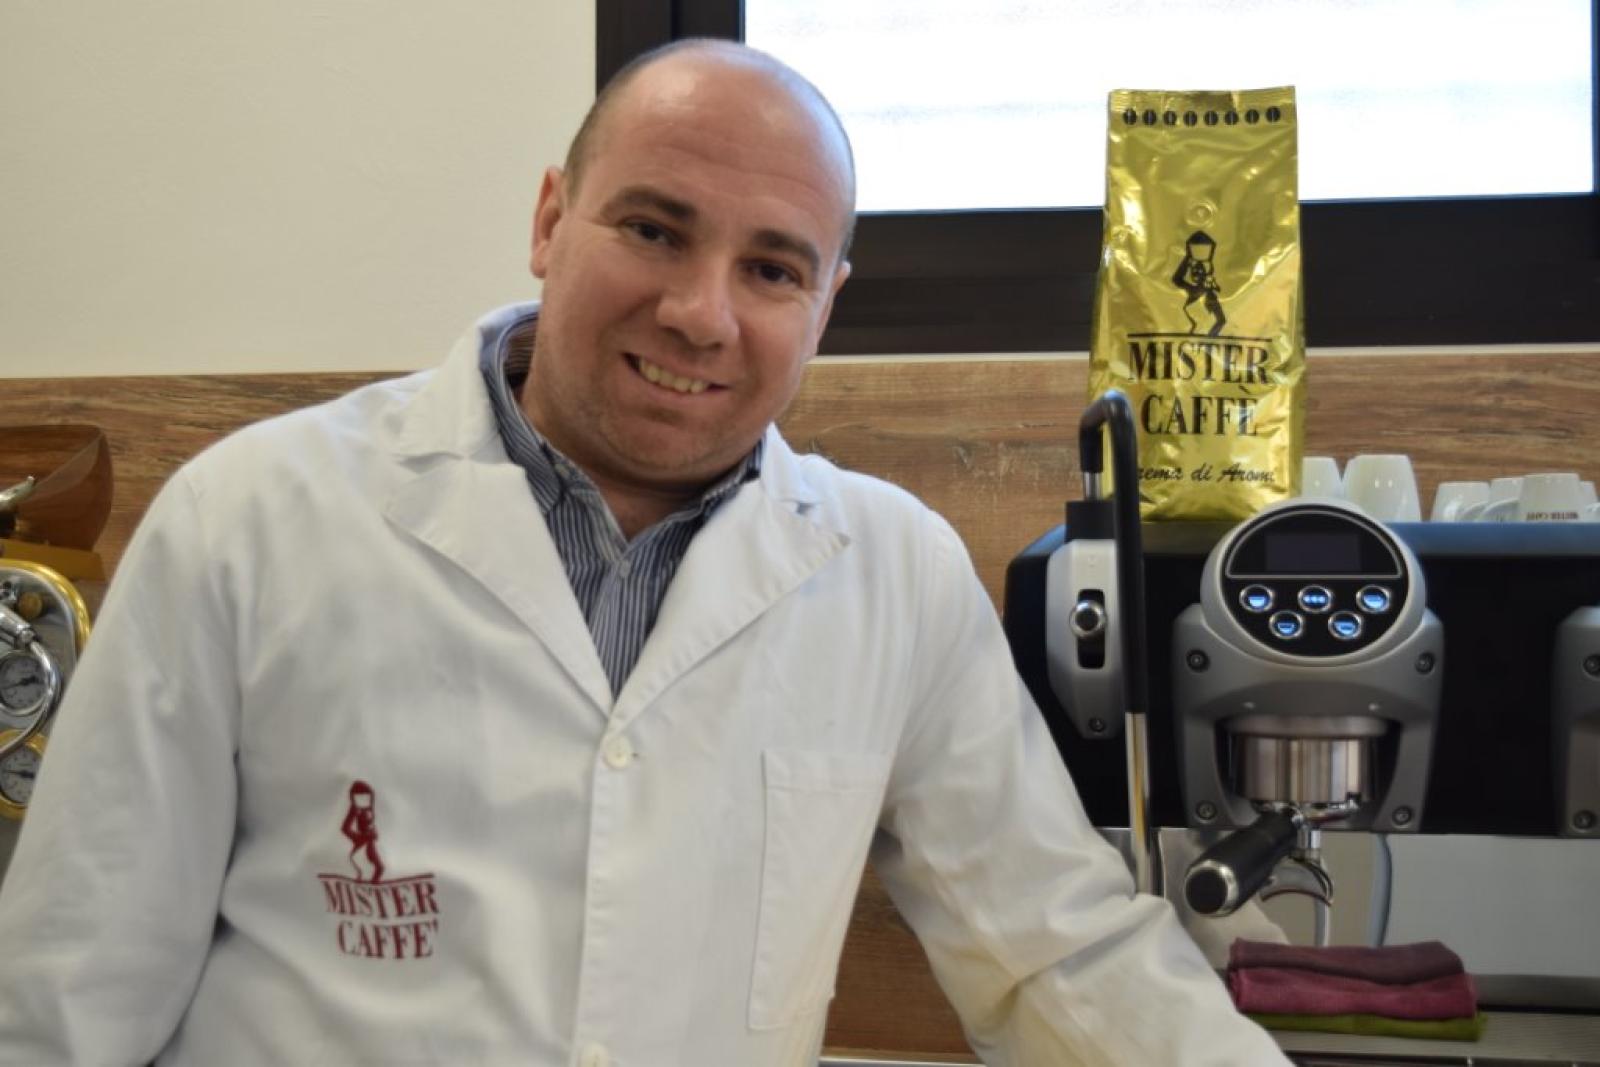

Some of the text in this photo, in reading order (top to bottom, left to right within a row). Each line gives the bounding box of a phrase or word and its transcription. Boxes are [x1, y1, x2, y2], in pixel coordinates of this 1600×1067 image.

[1128, 341, 1269, 384] MISTER
[1140, 385, 1258, 437] CAFFÈ
[1138, 465, 1184, 483] rema
[1190, 462, 1213, 482] di
[323, 880, 439, 919] MISTER
